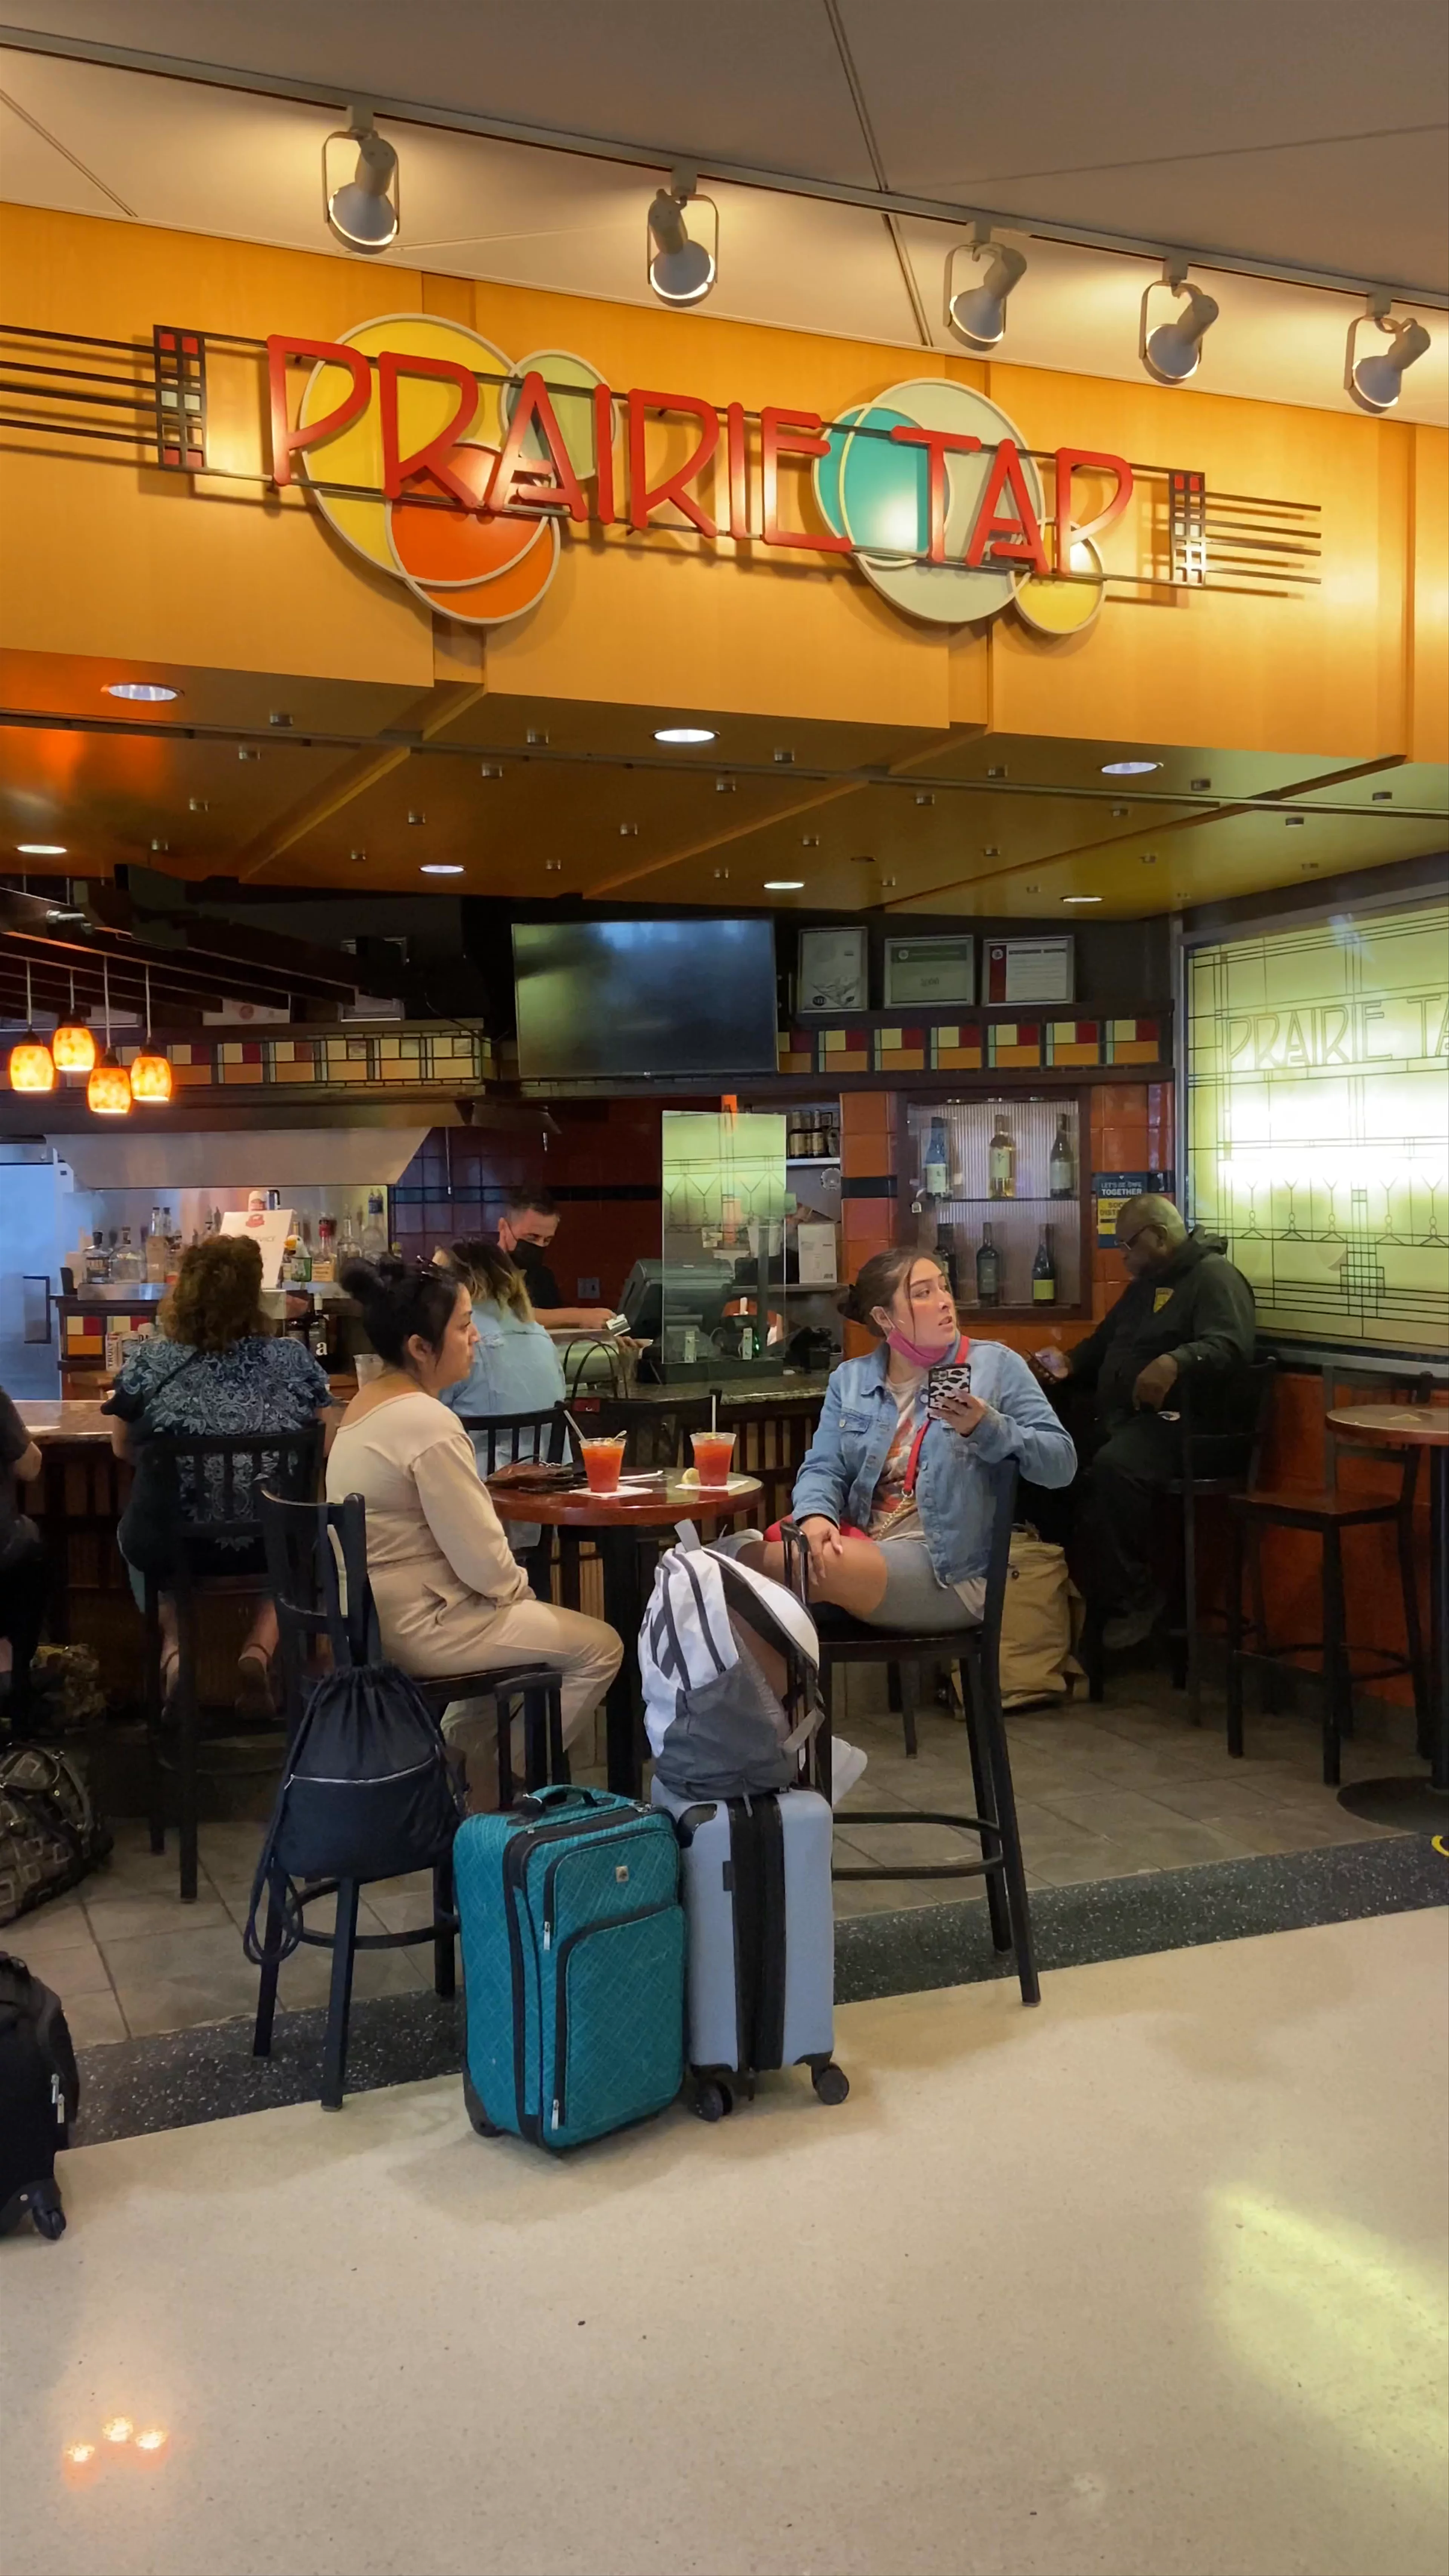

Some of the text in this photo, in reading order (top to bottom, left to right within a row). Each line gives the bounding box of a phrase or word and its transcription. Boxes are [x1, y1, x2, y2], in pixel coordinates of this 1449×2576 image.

[266, 334, 1132, 576] PRAIRIE TAP
[1226, 1001, 1392, 1072] PRAIRIE
